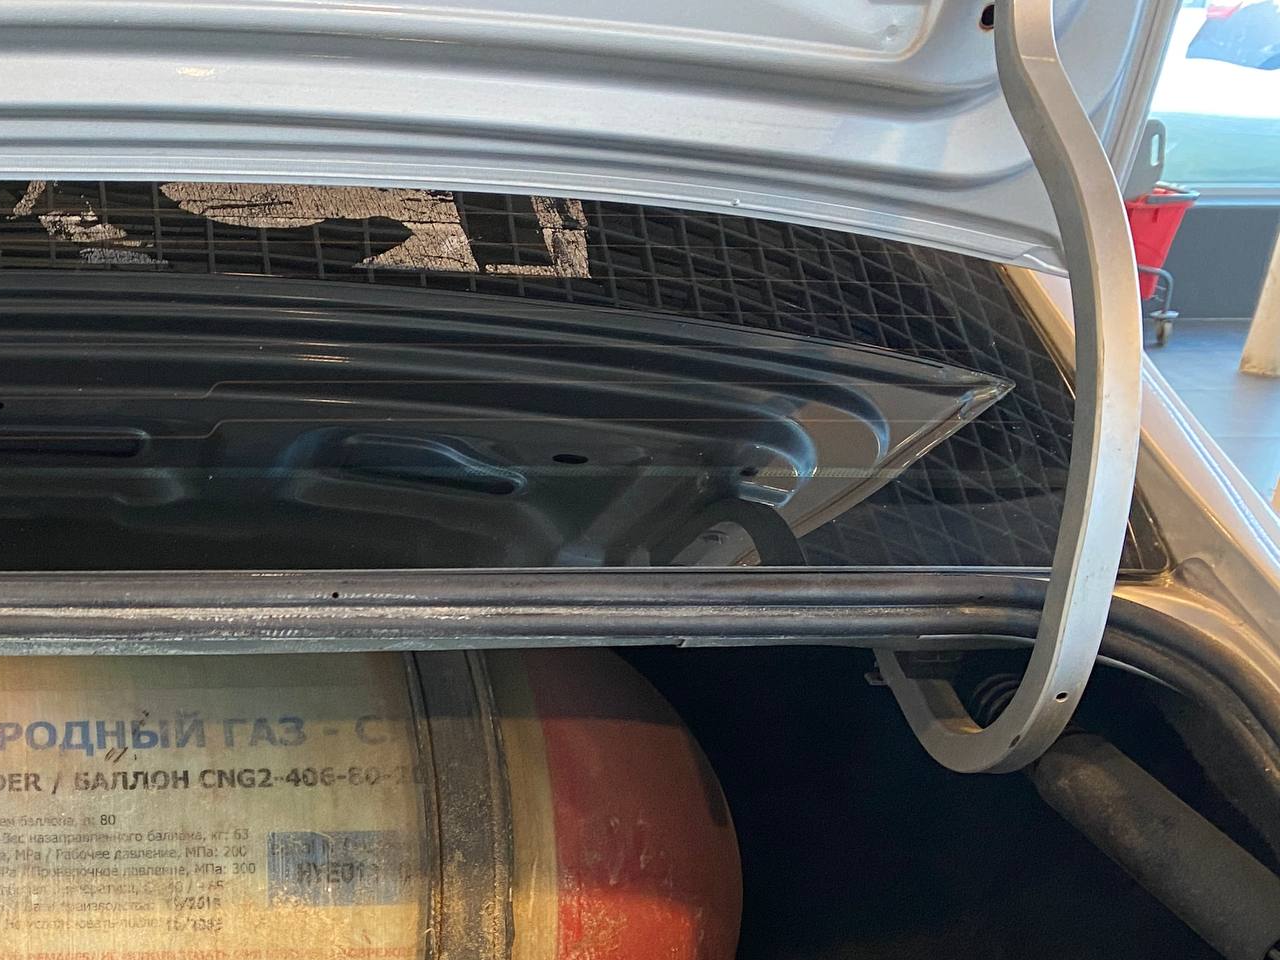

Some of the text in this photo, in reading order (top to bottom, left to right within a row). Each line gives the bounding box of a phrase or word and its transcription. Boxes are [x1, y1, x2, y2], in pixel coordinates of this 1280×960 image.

[223, 717, 306, 748] ГАЗ
[75, 771, 189, 791] БАЛЛОН
[100, 814, 116, 826] 80
